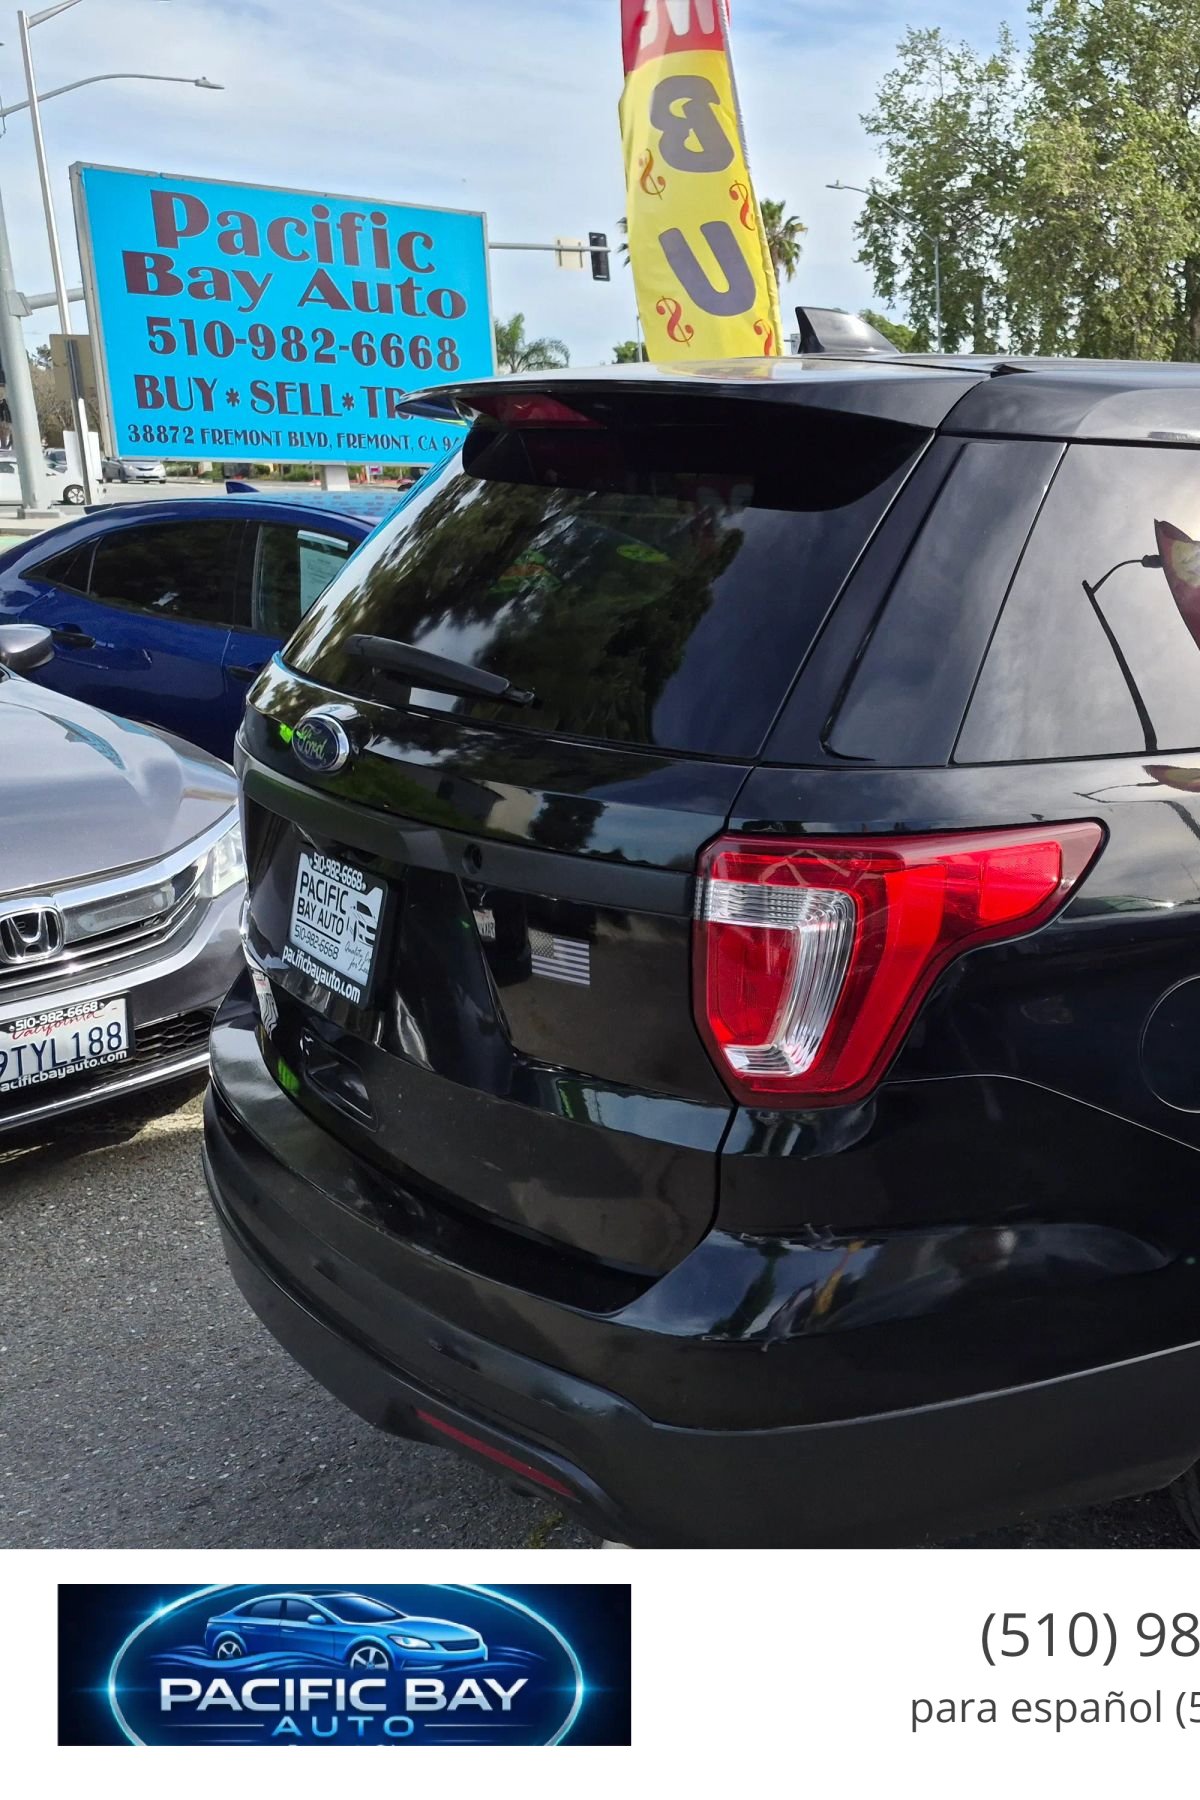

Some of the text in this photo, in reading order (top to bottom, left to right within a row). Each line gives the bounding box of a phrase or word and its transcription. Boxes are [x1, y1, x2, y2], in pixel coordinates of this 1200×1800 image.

[151, 189, 435, 274] Pacific
[122, 250, 467, 320] Bay Auto
[146, 316, 461, 371] 510-982-6668
[128, 424, 195, 445] 38872
[201, 428, 282, 448] FREMONT
[288, 431, 332, 451] BLVD,
[337, 433, 415, 453] FREMONT,
[418, 435, 438, 452] CA
[300, 871, 349, 915] PACIFIC
[312, 852, 364, 891] 510-982-6668
[297, 897, 345, 936] BAY AUTO
[294, 925, 340, 960] 510-982-6668
[282, 946, 361, 1004] pacificbayauto.com
[15, 1001, 99, 1032] 510-982-6668
[0, 1021, 122, 1080] 9TYL188
[0, 1050, 127, 1093] acificbayauto.com
